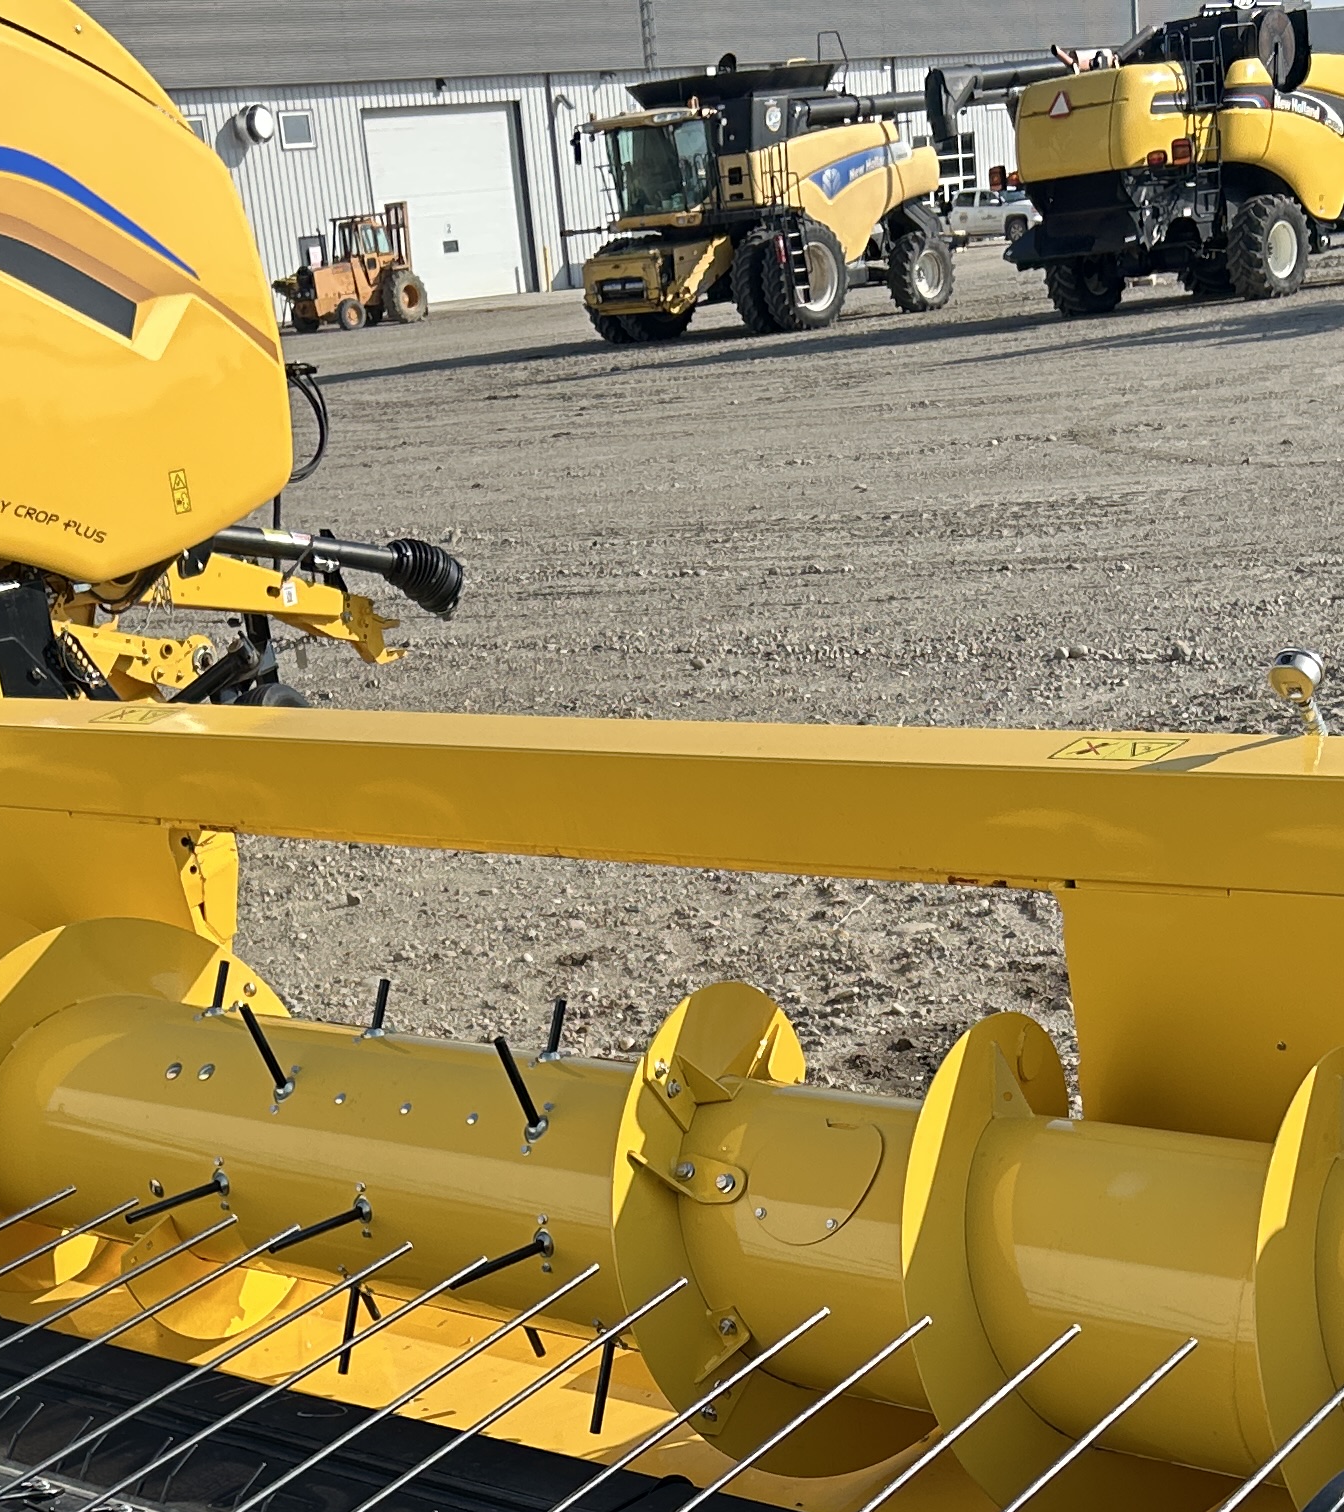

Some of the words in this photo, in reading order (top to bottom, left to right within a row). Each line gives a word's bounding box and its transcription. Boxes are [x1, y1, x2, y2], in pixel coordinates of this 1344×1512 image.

[1274, 94, 1292, 111] New
[1291, 97, 1321, 121] Holland
[13, 504, 60, 526] CROP
[63, 519, 108, 545] PLUS
